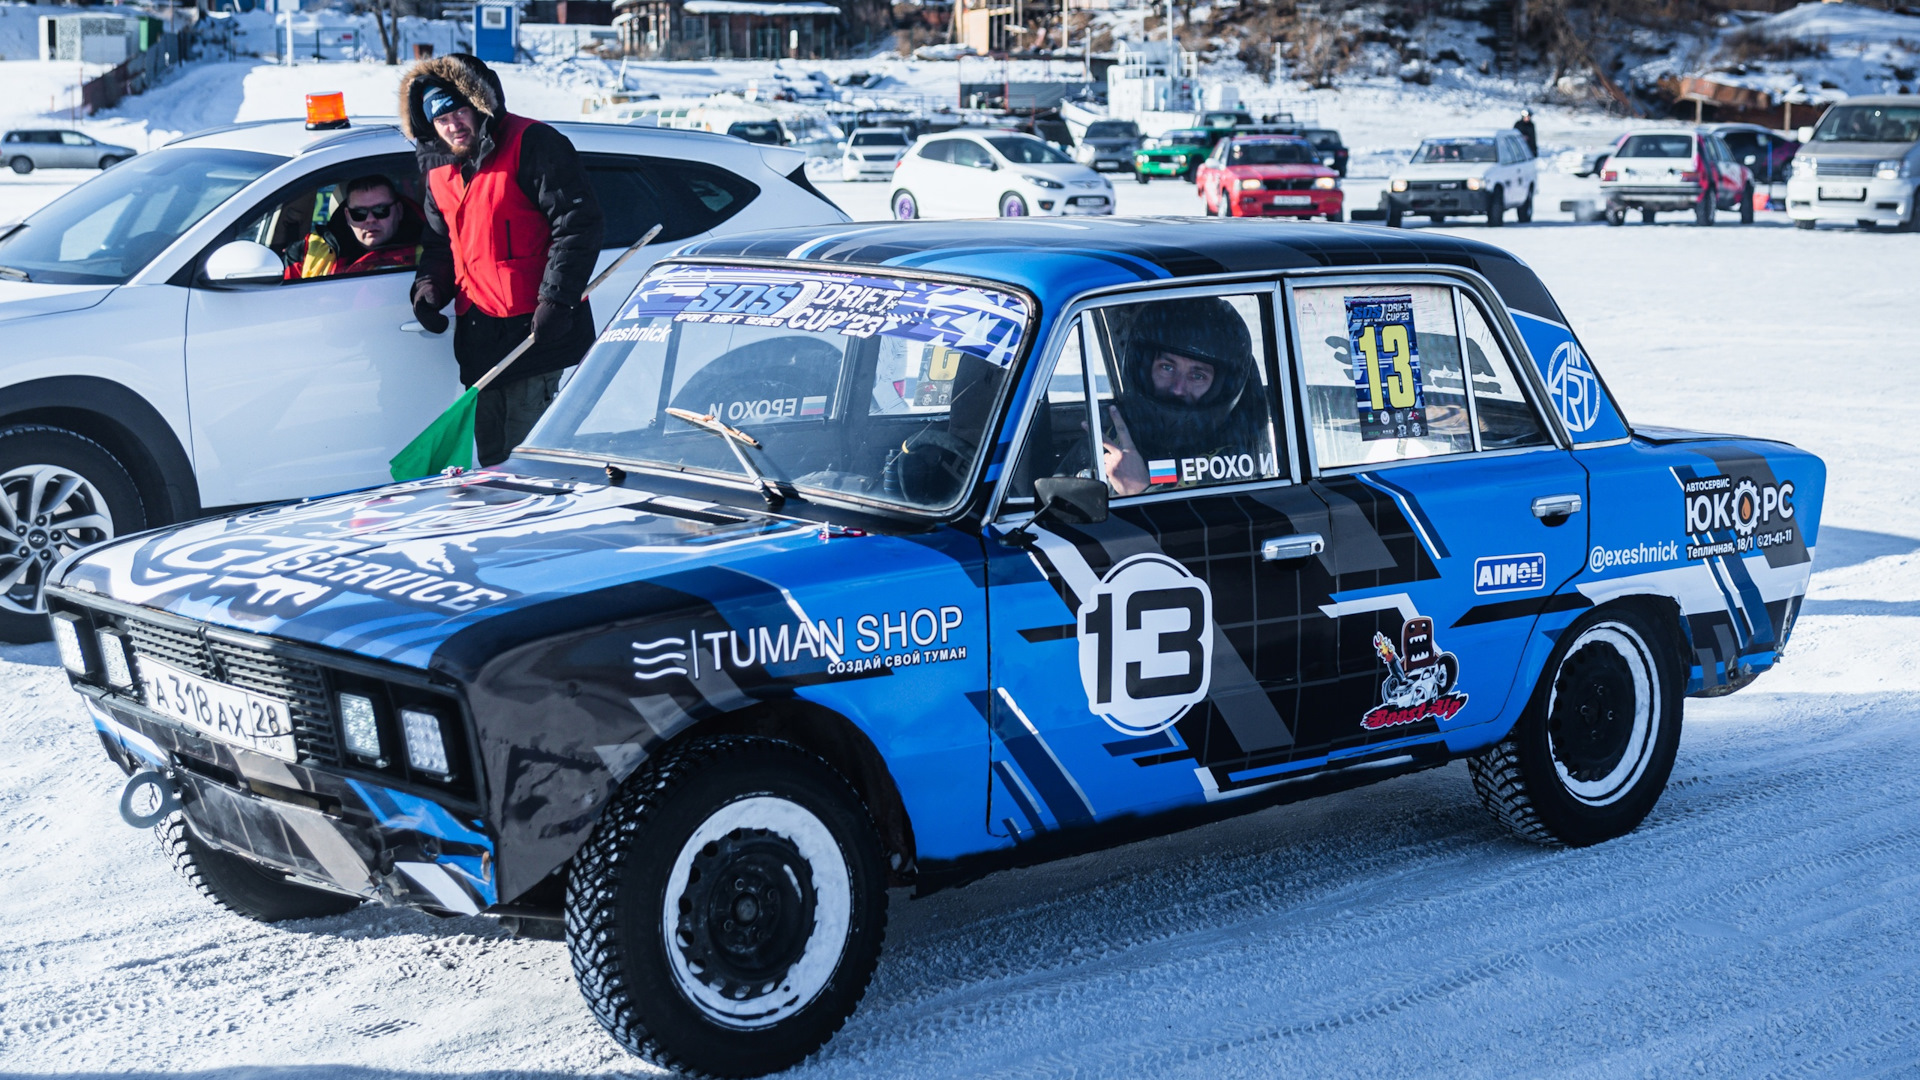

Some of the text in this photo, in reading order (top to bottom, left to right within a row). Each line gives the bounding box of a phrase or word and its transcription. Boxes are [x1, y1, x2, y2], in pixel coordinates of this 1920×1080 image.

[815, 283, 904, 311] DRIFT
[788, 308, 885, 338] CUP'23
[1358, 325, 1416, 410] 13
[1181, 454, 1254, 481] ЕРОХО
[1686, 478, 1730, 492] АВТОСЕРВИС
[1589, 540, 1679, 573] @exeshnick
[1687, 542, 1735, 558] Тепличная,
[1737, 536, 1753, 551] 18/1
[272, 550, 507, 611] SERVICE
[703, 606, 963, 671] TUMAN SHOP
[1085, 586, 1205, 704] 13
[827, 647, 966, 675] СОЗДАЙ СВОЙ ТУМАН
[252, 700, 281, 736] 28
[1365, 698, 1461, 728] Boost Up
